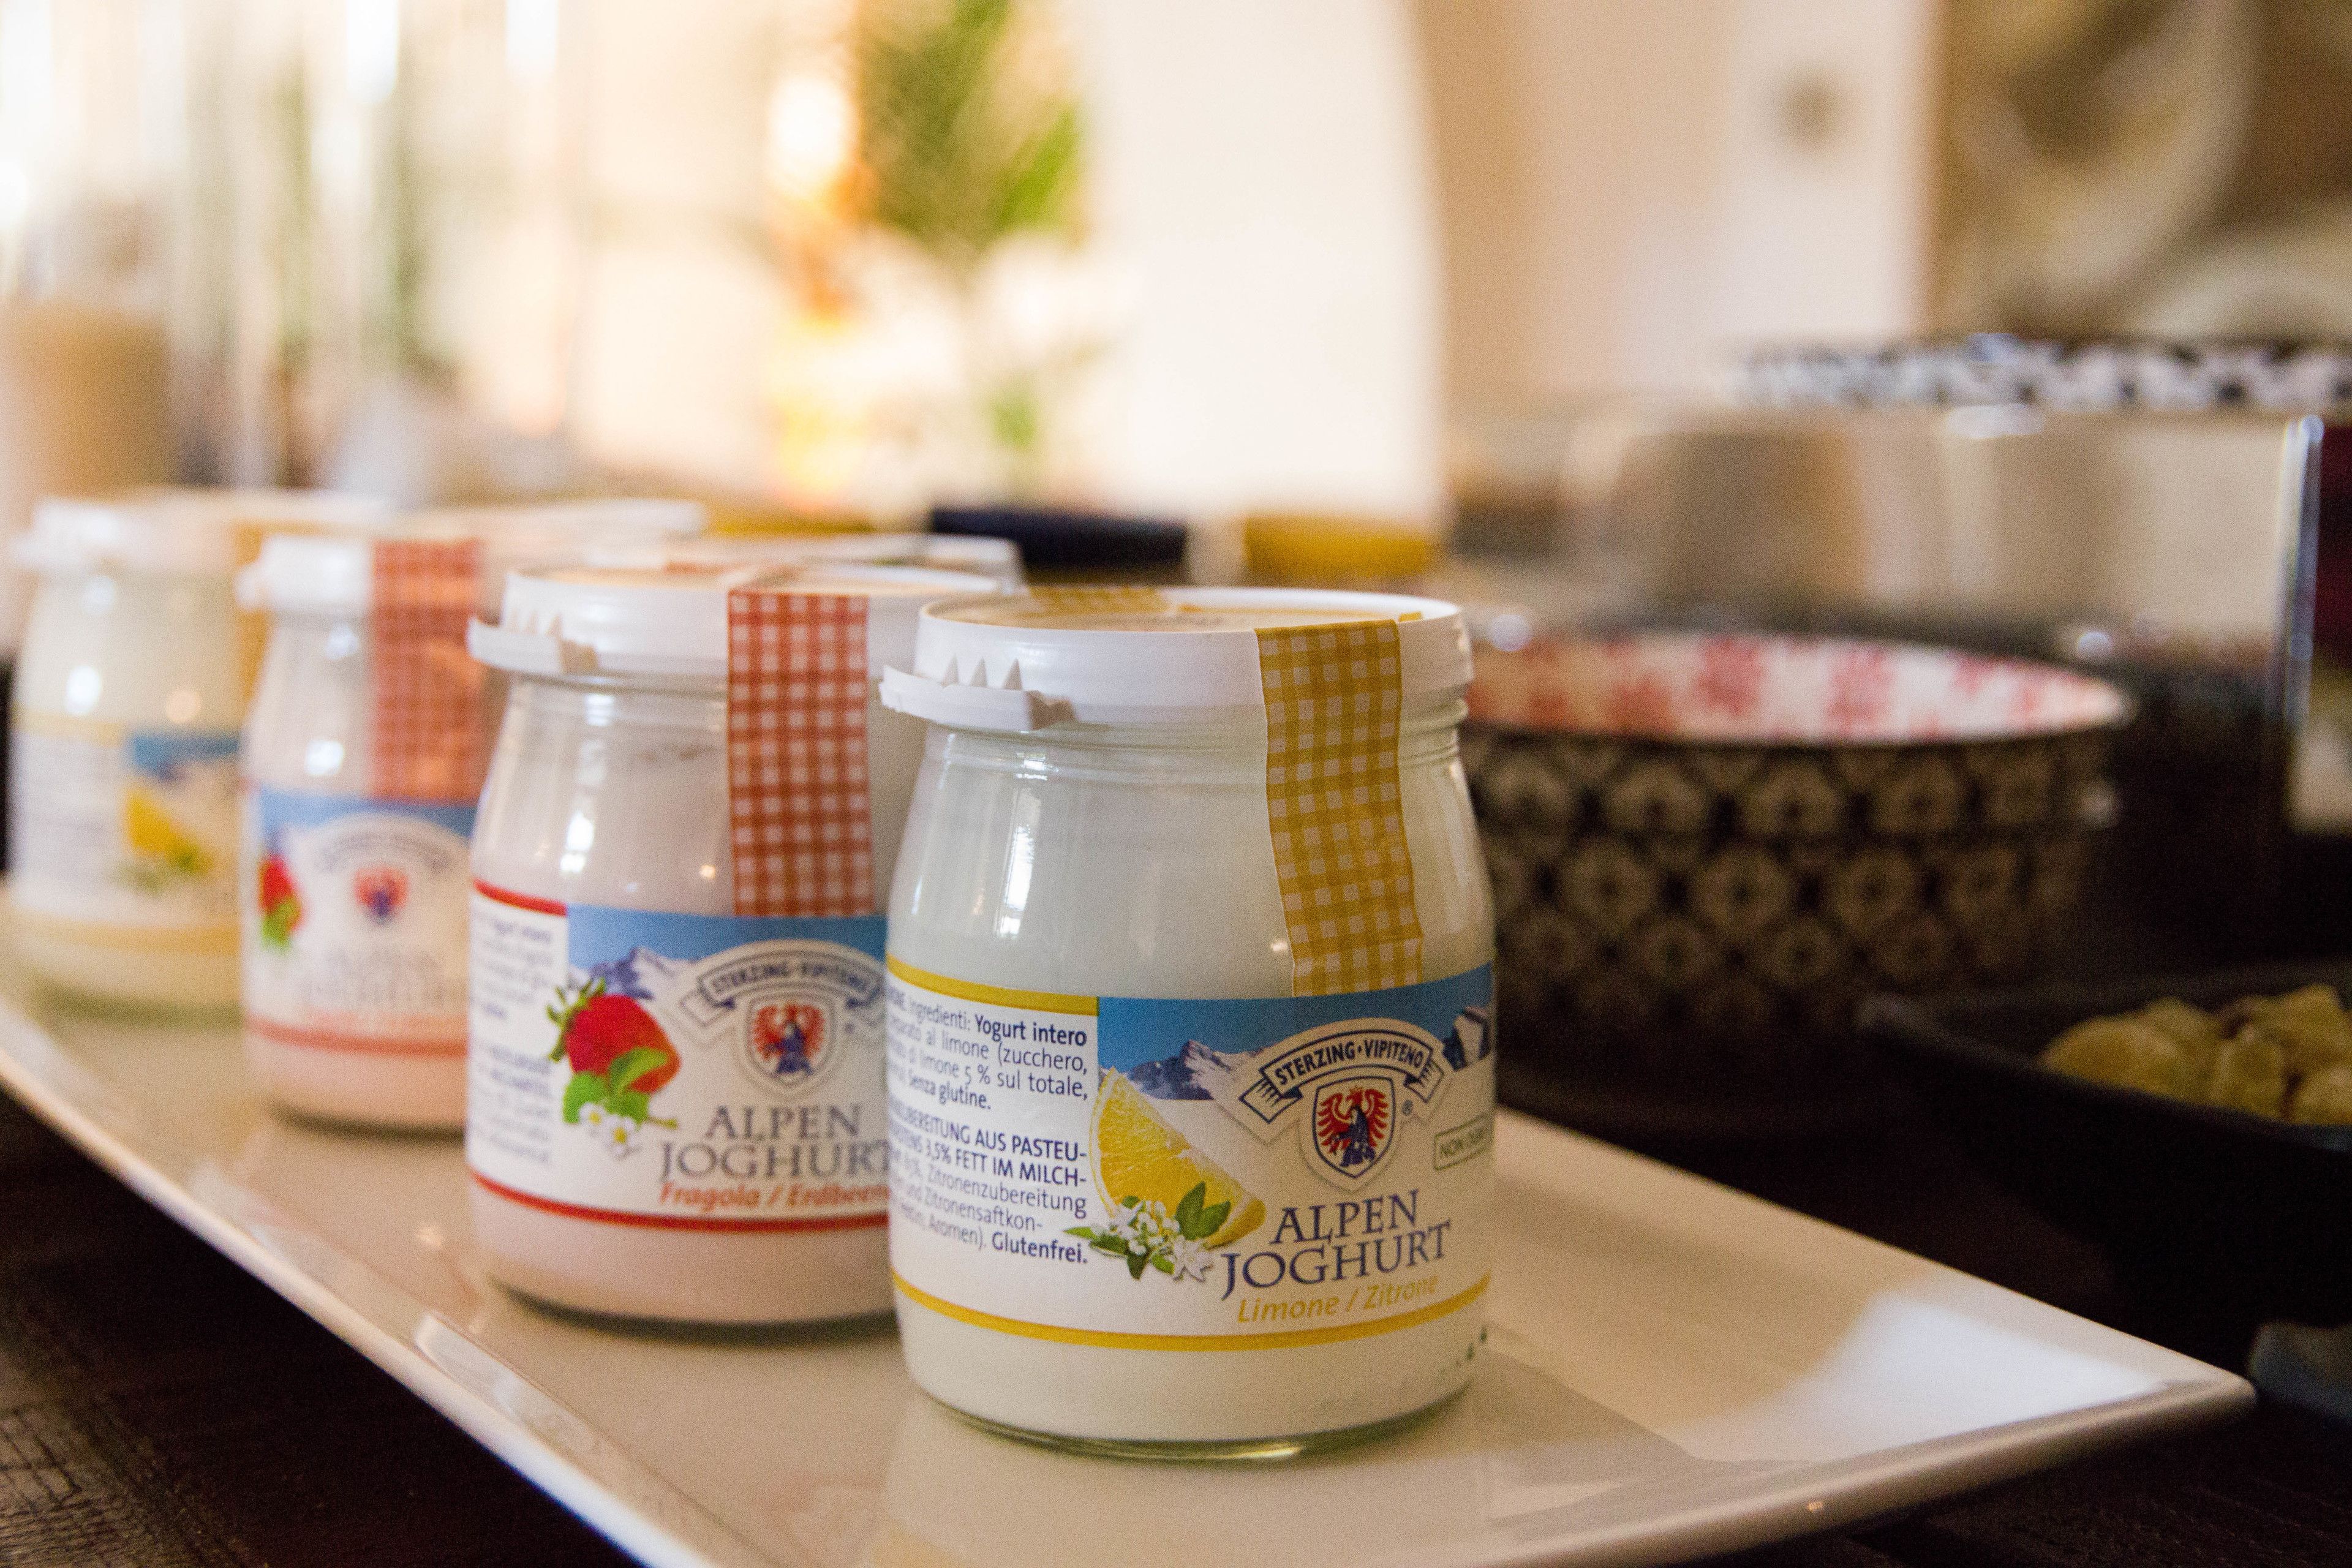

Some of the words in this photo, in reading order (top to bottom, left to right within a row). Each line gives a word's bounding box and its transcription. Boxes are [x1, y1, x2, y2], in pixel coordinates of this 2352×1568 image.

[974, 1014, 1026, 1042] Yogurt
[1033, 1022, 1088, 1046] intero
[941, 1029, 989, 1060] limone
[997, 1041, 1088, 1075] (zucchero,
[1274, 1041, 1355, 1085] STERZING
[1363, 1040, 1424, 1069] VIPITENO
[938, 1080, 992, 1110] glutine.
[977, 1063, 991, 1085] %
[997, 1069, 1021, 1090] sul
[1028, 1071, 1088, 1100] totale,
[706, 1104, 861, 1140] ALPEN
[975, 1129, 1007, 1152] AUS
[1012, 1134, 1088, 1162] PASTEU-
[956, 1147, 988, 1172] FETT
[993, 1157, 1014, 1178] IM
[1019, 1161, 1087, 1187] MILCH-
[660, 1181, 761, 1215] Fragola
[767, 1185, 783, 1207] /
[925, 1185, 1043, 1232] Zitronensaftkon-
[929, 1163, 1088, 1219] Zitronenzubereitung
[1268, 1188, 1419, 1245] ALPEN
[992, 1231, 1088, 1264] Glutenfrei.
[1220, 1218, 1451, 1302] JOGHURT
[1237, 1297, 1340, 1324] Limone
[1347, 1289, 1358, 1313] /
[1364, 1275, 1439, 1311] Zitrone
